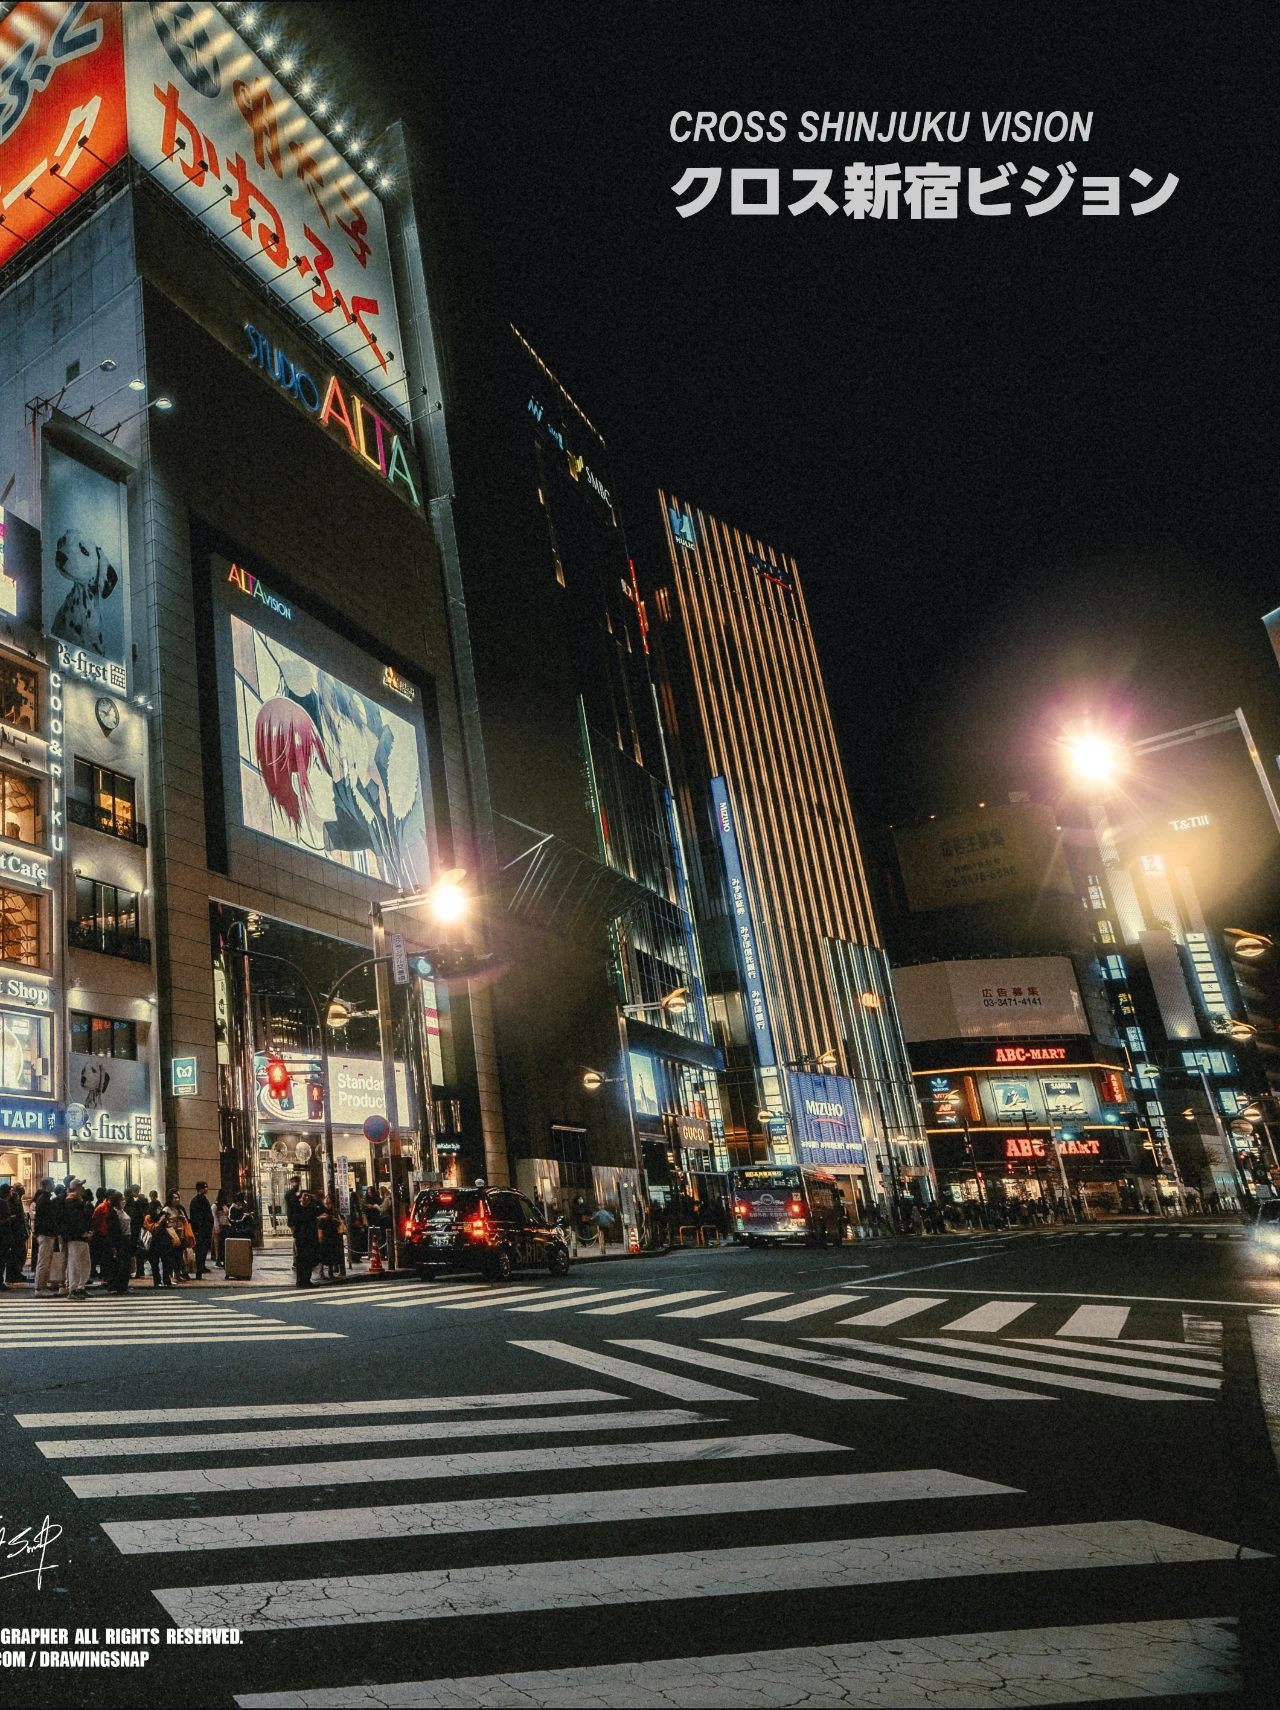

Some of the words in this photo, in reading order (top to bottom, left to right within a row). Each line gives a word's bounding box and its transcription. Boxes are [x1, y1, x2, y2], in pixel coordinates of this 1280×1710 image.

[153, 80, 389, 374] かねふく
[244, 323, 320, 412] STUDIO
[320, 375, 420, 506] ALTA
[227, 563, 265, 604] ALTA
[263, 593, 292, 621] VISION
[720, 802, 730, 833] MIZUHO
[9, 856, 47, 880] Cafe
[7, 979, 48, 1004] Shop
[982, 986, 1039, 998] 広告募集
[983, 998, 1042, 1007] 03-3471-4141
[996, 1047, 1066, 1062] ABC-MART
[337, 1073, 384, 1092] Standar
[338, 1091, 387, 1109] Product
[805, 1099, 843, 1117] MIZUHO
[1, 1109, 43, 1129] TAPI
[683, 1126, 705, 1142] GUCCI
